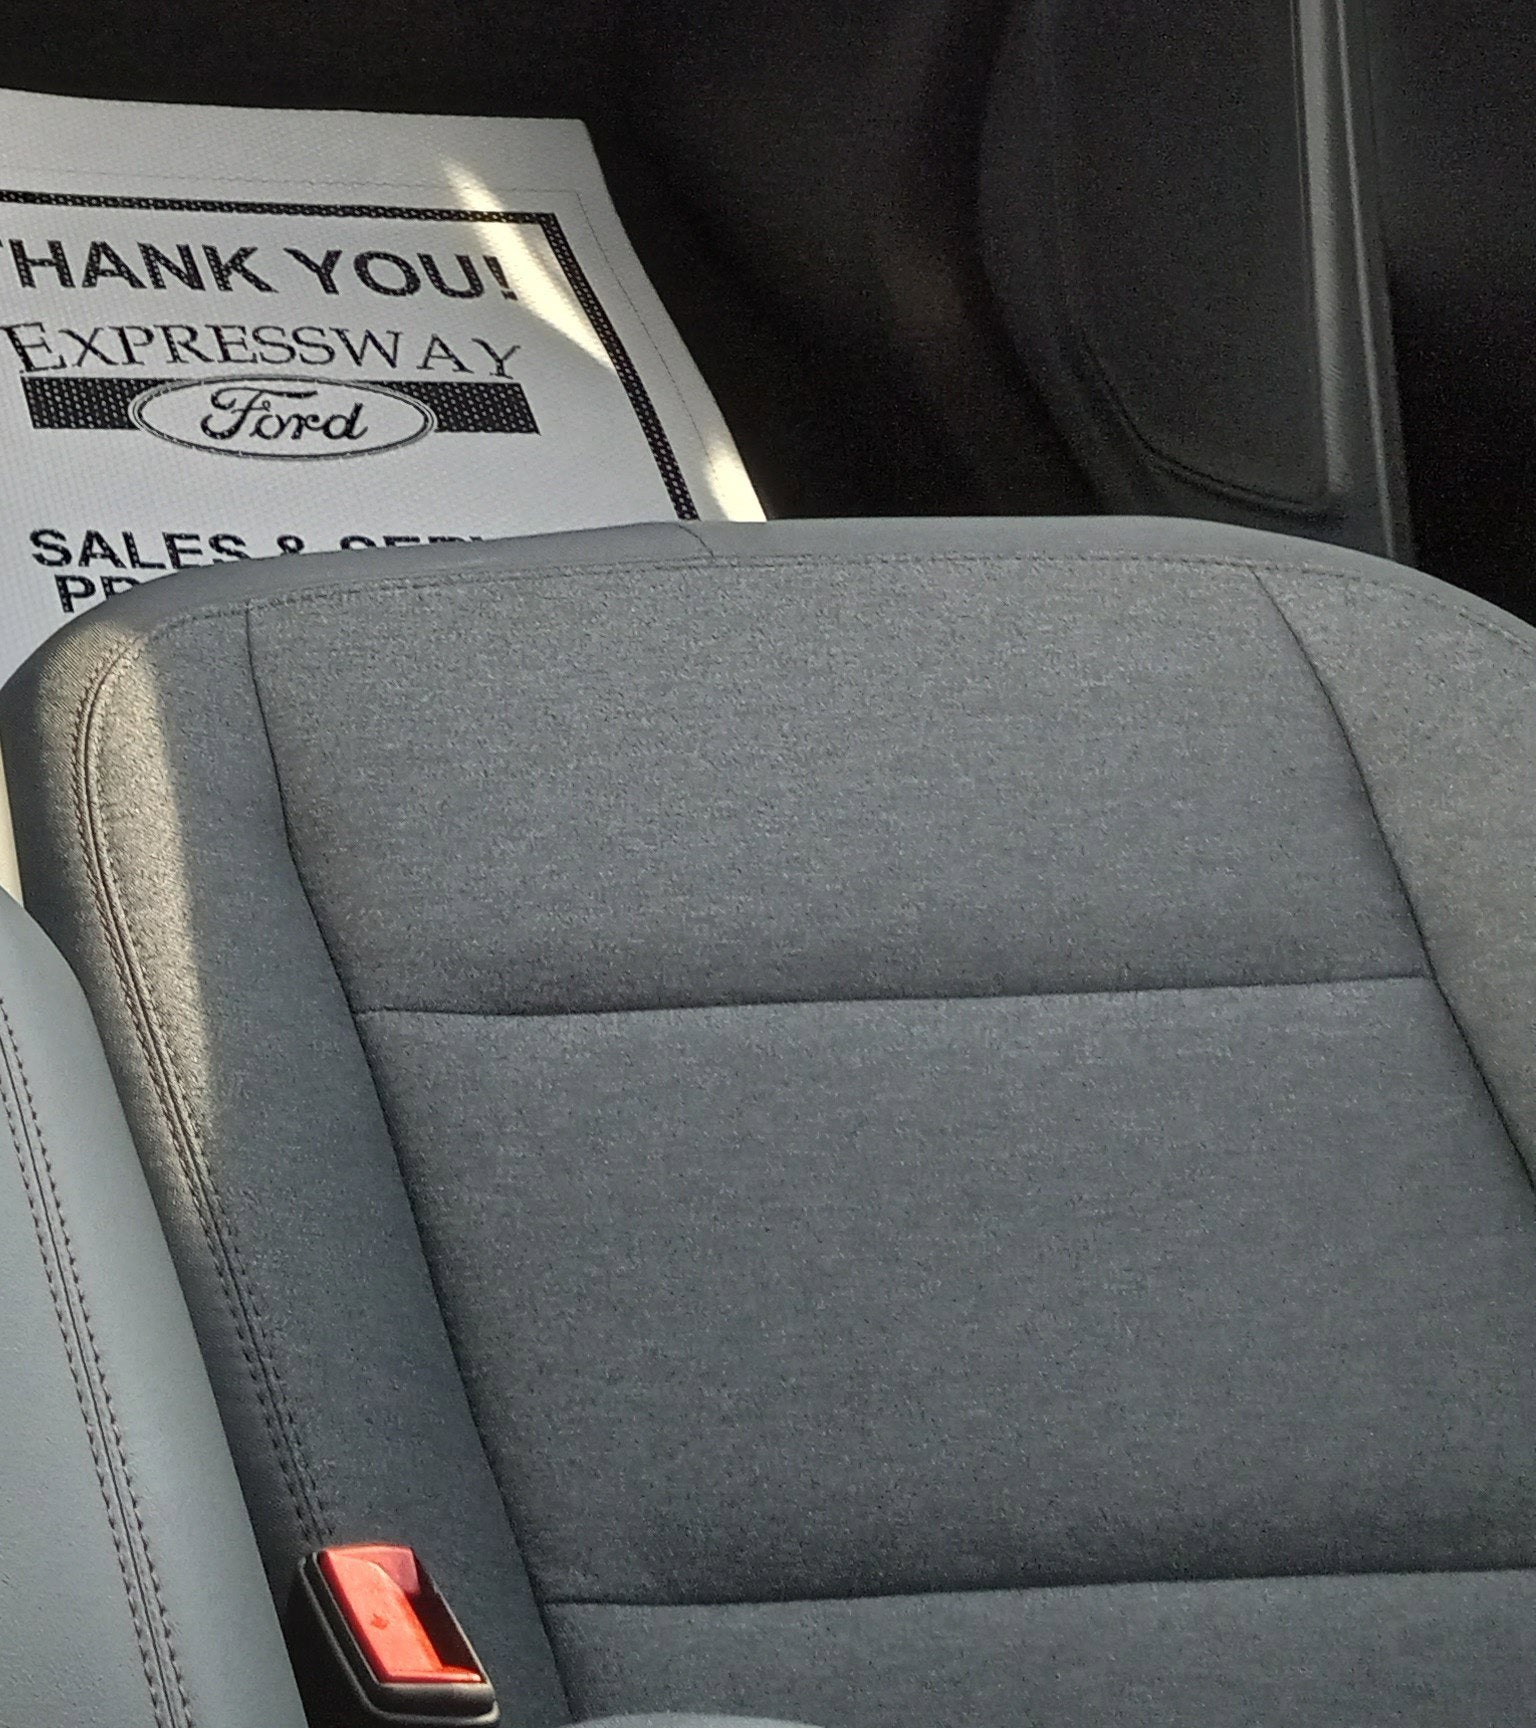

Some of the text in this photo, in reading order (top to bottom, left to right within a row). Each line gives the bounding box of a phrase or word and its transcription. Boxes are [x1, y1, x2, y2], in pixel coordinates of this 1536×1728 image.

[284, 246, 520, 302] YOU!
[200, 384, 370, 443] Ford
[28, 528, 254, 570] SALES
